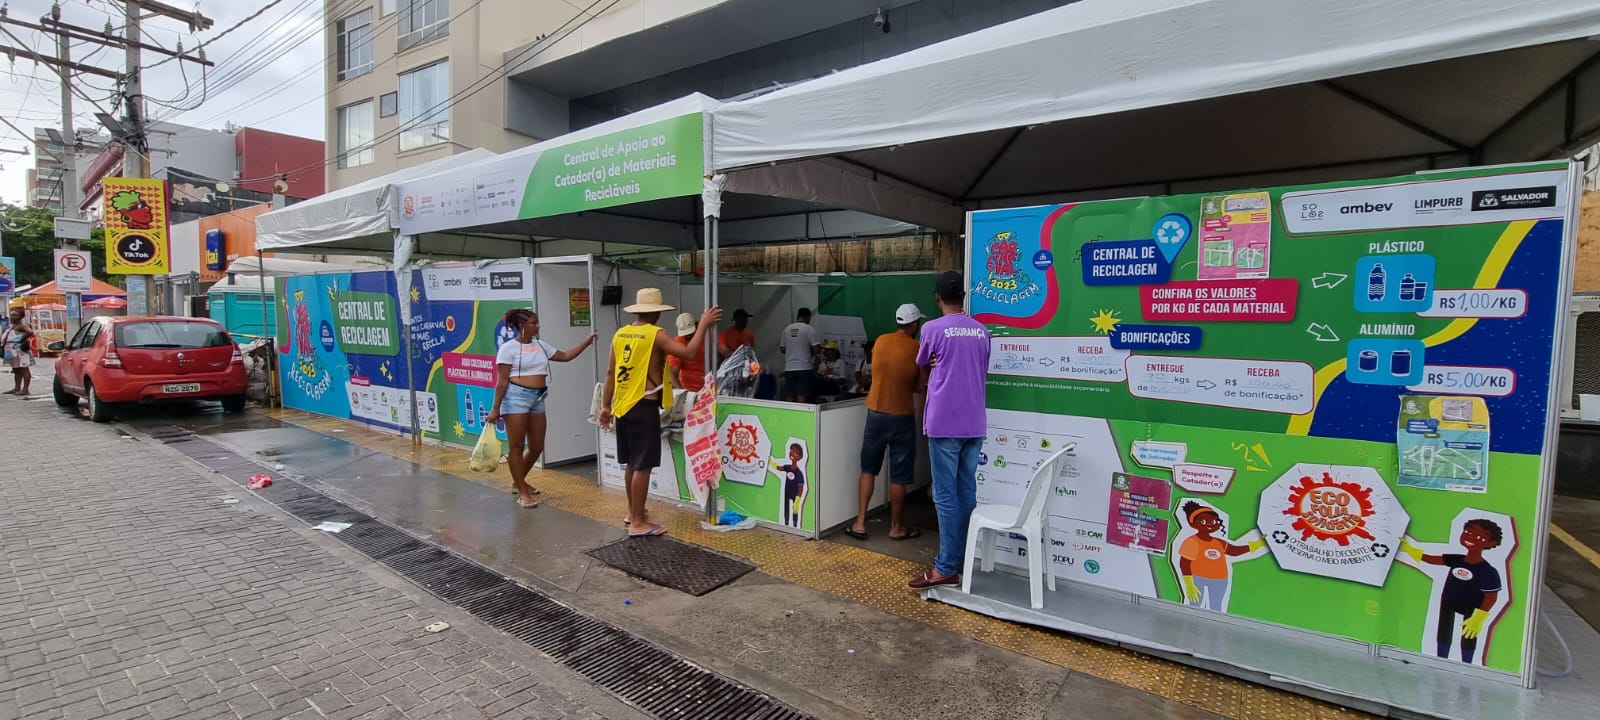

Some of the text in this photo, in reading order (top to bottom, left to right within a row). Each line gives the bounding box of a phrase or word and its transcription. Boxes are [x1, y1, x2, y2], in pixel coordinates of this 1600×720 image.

[564, 135, 666, 166] Central de Apoio ao
[554, 151, 677, 187] Catador(a) de Materiais
[585, 180, 641, 202] Recicláveis
[1501, 192, 1549, 202] SALVADOR
[1340, 202, 1393, 215] ambev
[1414, 197, 1463, 209] LIMPURB
[1369, 240, 1425, 254] PLÁSTICO
[1093, 246, 1156, 261] CENTRAL DE
[1092, 263, 1157, 277] RECICLAGEM
[990, 279, 1018, 290] 2023
[975, 281, 1040, 305] RECICLAGEM
[1152, 287, 1257, 299] CONFIRA OS VALORES
[1152, 303, 1287, 314] POR KG DE CADA MATERIAL
[1440, 297, 1456, 309] R$
[338, 301, 386, 321] CENTRAL DE
[944, 327, 986, 339] SEGURANÇA
[1359, 323, 1415, 336] ALUMÍNIO
[341, 326, 390, 347] RECICLAGEM
[1120, 331, 1191, 346] BONIFICAÇÕES
[1000, 343, 1031, 352] ENTREGUE
[1077, 346, 1104, 355] RECEBA
[1146, 363, 1185, 373] ENTREGUE
[1247, 367, 1280, 377] RECEBA
[1174, 376, 1190, 385] kgs
[1225, 378, 1237, 388] R$
[1428, 373, 1444, 385] R$
[1137, 384, 1148, 392] de
[1224, 390, 1236, 398] de
[1181, 469, 1213, 479] Respeite
[1309, 490, 1351, 507] ECO
[1310, 504, 1349, 519] FOLIA
[1087, 530, 1103, 540] CAR
[1294, 538, 1335, 558] TRABALHO
[1286, 544, 1375, 566] PRESERVA O MEIO AMBIENTE
